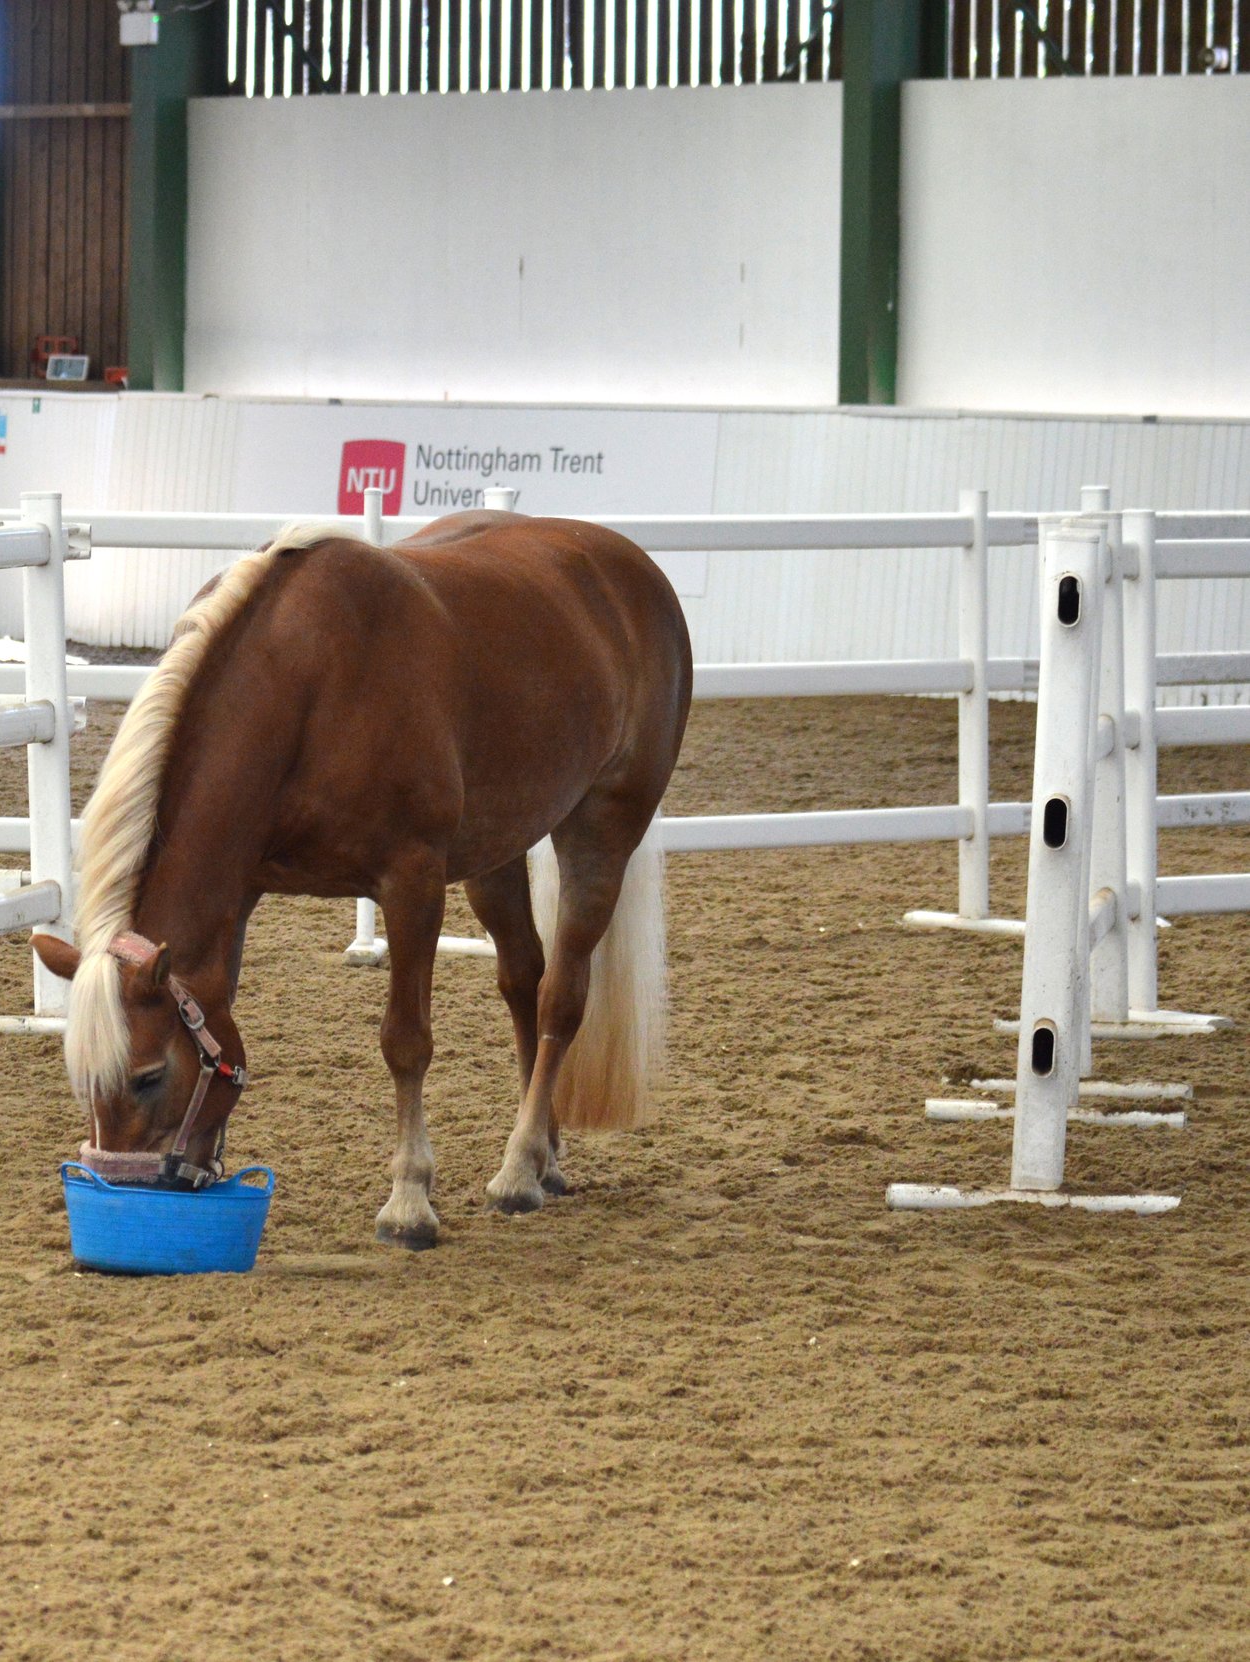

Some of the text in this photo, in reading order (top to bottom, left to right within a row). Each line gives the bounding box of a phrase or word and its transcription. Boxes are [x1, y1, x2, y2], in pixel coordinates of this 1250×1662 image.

[415, 443, 605, 477] Nottingham Trent
[346, 466, 397, 494] NTU
